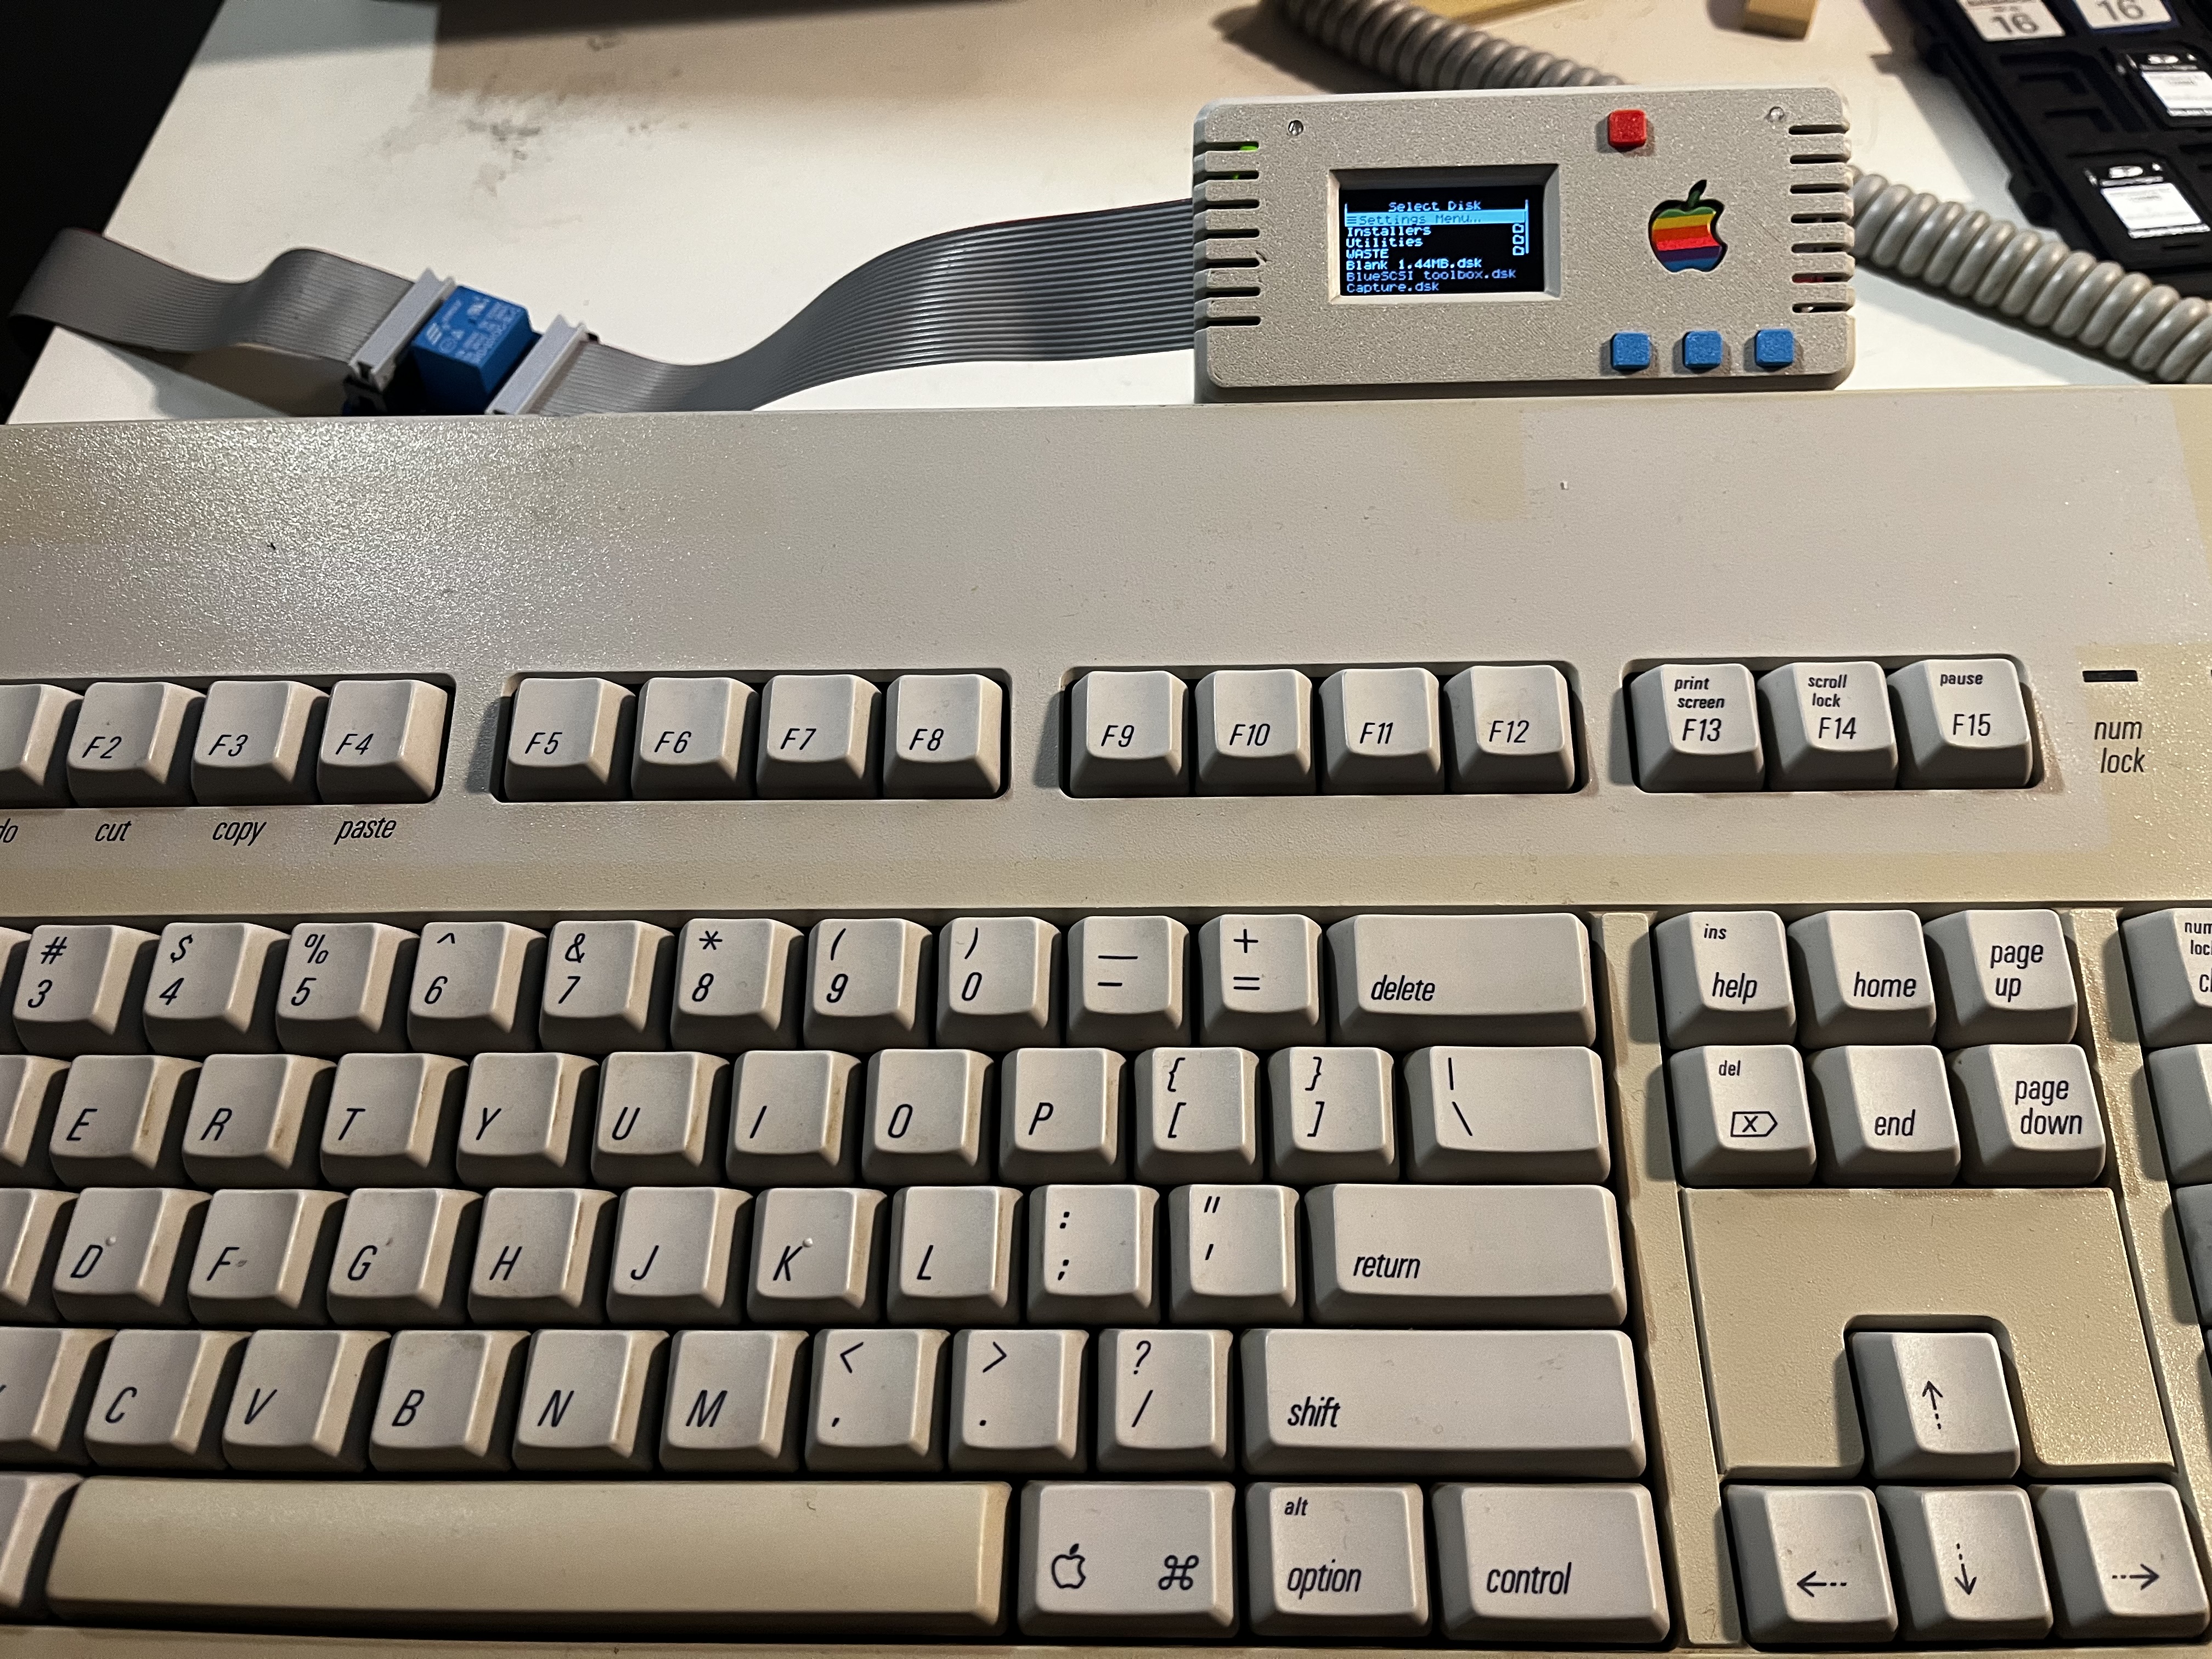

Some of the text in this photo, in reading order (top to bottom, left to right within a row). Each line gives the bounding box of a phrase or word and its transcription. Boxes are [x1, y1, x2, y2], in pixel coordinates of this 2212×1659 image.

[1991, 13, 2039, 35] 16
[2098, 0, 2144, 21] 16
[1389, 201, 1481, 212] Select Disk
[1347, 226, 1431, 236] Installers
[1359, 215, 1427, 227] Settings
[1346, 237, 1424, 248] Utilities
[1346, 249, 1389, 259] WASTE
[1346, 258, 1482, 270] Blank 1.44MB.dsk
[1346, 269, 1516, 281] BlueSCSI toolbox.dsk
[1346, 281, 1439, 294] Capture.dsk
[1674, 676, 1709, 692] print
[1808, 674, 1847, 689] scroll
[1940, 674, 1983, 687] pause
[1677, 698, 1725, 709] screen
[1812, 693, 1841, 708] lock
[1101, 725, 1135, 748] F9
[1229, 723, 1271, 746] F10
[1359, 722, 1393, 744] F11
[1489, 720, 1530, 743] F12
[1682, 718, 1722, 742] F13
[1819, 716, 1857, 740] F14
[1953, 713, 1991, 736] F15
[2094, 721, 2142, 740] num
[82, 736, 122, 759] F2
[208, 734, 249, 757] F3
[335, 733, 374, 755] F4
[524, 732, 563, 755] F5
[654, 731, 692, 754] F6
[780, 728, 817, 751] F7
[909, 728, 944, 751] F8
[2100, 747, 2146, 774] lock
[95, 820, 132, 842] cut
[212, 821, 267, 847] copy
[333, 817, 397, 845] paste
[830, 928, 847, 961] (
[964, 927, 978, 960] )
[1233, 928, 1259, 953] +
[1704, 923, 1727, 940] ins
[41, 936, 67, 965] #
[170, 934, 193, 963] $
[304, 934, 329, 964] %
[565, 933, 586, 963] &
[1990, 944, 2044, 969] page
[2190, 939, 2212, 956] loc
[27, 979, 53, 1008] 3
[159, 977, 184, 1006] 4
[291, 977, 317, 1006] 5
[424, 975, 448, 1005] 6
[558, 975, 581, 1004] 7
[692, 973, 714, 1002] 8
[826, 973, 849, 1003] 9
[961, 972, 983, 1001] 0
[1233, 977, 1261, 991] =
[1370, 974, 1435, 1002] delete
[1712, 972, 1757, 1005] help
[1853, 971, 1917, 997] home
[1995, 978, 2022, 1003] up
[1167, 1057, 1186, 1092] {
[1305, 1056, 1322, 1091] }
[1718, 1060, 1741, 1076] del
[2015, 1080, 2069, 1106] page
[66, 1108, 98, 1141] E
[200, 1108, 233, 1141] R
[338, 1108, 366, 1141] T
[476, 1107, 502, 1141] Y
[612, 1107, 641, 1141] U
[888, 1103, 913, 1138] O
[1028, 1102, 1054, 1136] P
[1167, 1102, 1187, 1138] [
[1307, 1101, 1325, 1137] ]
[1874, 1109, 1916, 1137] end
[2021, 1109, 2083, 1135] down
[1059, 1211, 1070, 1229] :
[70, 1244, 103, 1279] D
[206, 1246, 240, 1281] F
[347, 1245, 377, 1281] G
[489, 1245, 523, 1281] H
[630, 1245, 659, 1280] J
[772, 1245, 803, 1282] K
[916, 1245, 934, 1280] L
[1353, 1254, 1421, 1279] return
[840, 1341, 864, 1374] <
[982, 1341, 1007, 1373] >
[1133, 1340, 1152, 1375] ?
[105, 1386, 137, 1424] C
[244, 1388, 278, 1425] V
[392, 1389, 425, 1427] B
[537, 1390, 574, 1427] N
[686, 1390, 728, 1427] M
[1131, 1390, 1153, 1427] /
[1287, 1396, 1341, 1427] shift
[1284, 1497, 1308, 1516] alt
[1287, 1559, 1362, 1600] option
[1486, 1561, 1572, 1595] control
